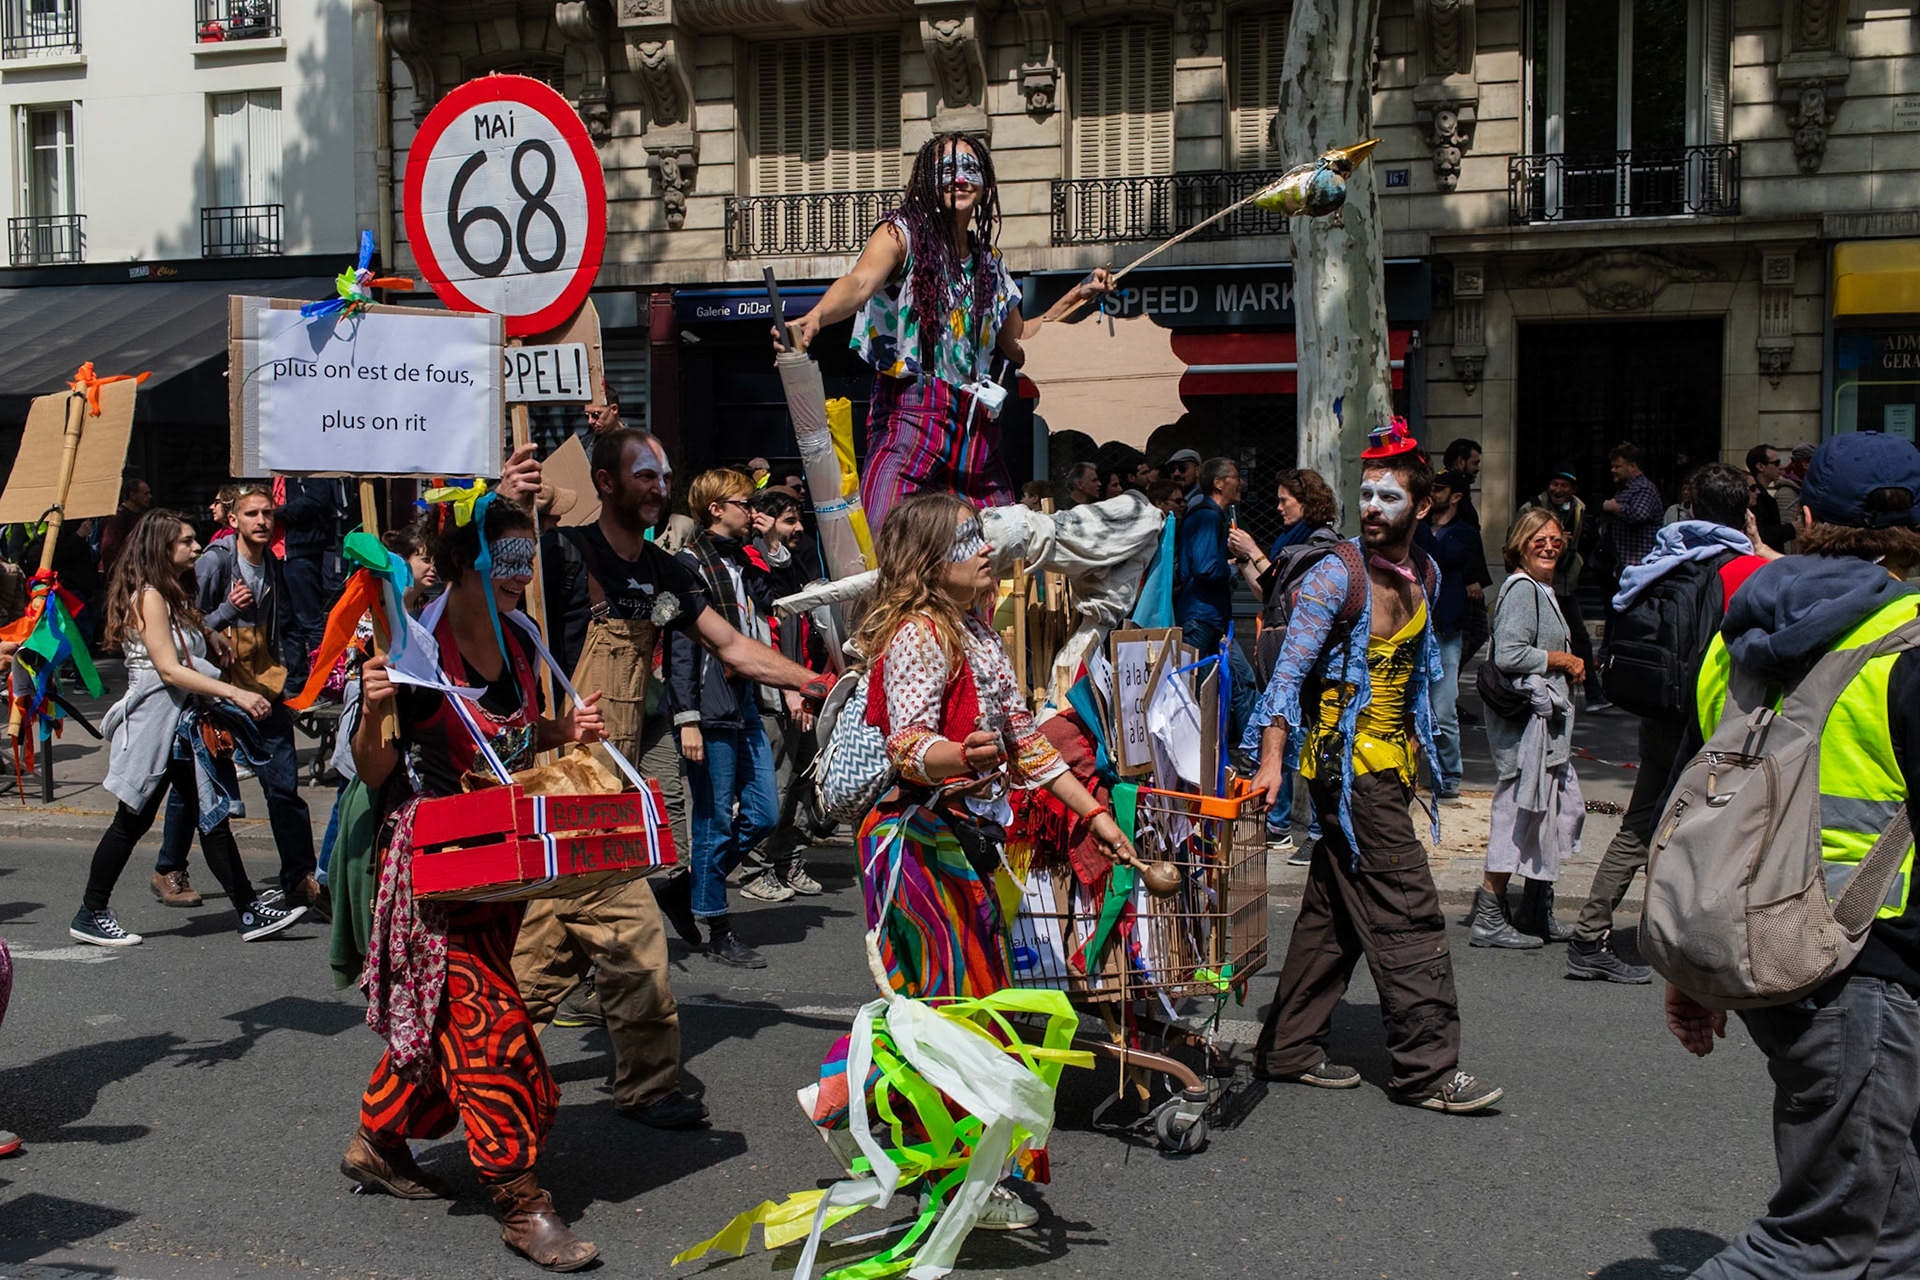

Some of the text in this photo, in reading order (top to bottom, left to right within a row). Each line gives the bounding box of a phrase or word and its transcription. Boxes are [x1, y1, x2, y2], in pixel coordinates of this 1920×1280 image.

[1389, 171, 1406, 185] 167
[447, 138, 567, 278] 68
[696, 305, 731, 318] Galerie
[1104, 285, 1199, 315] SPEED
[273, 358, 475, 387] plus on est de fous,
[322, 409, 427, 432] plus on rit
[1126, 663, 1131, 686] à
[1133, 662, 1141, 686] la
[1129, 720, 1144, 744] à la
[553, 800, 640, 829] BOUFFONS
[570, 838, 647, 870] Mc ROND
